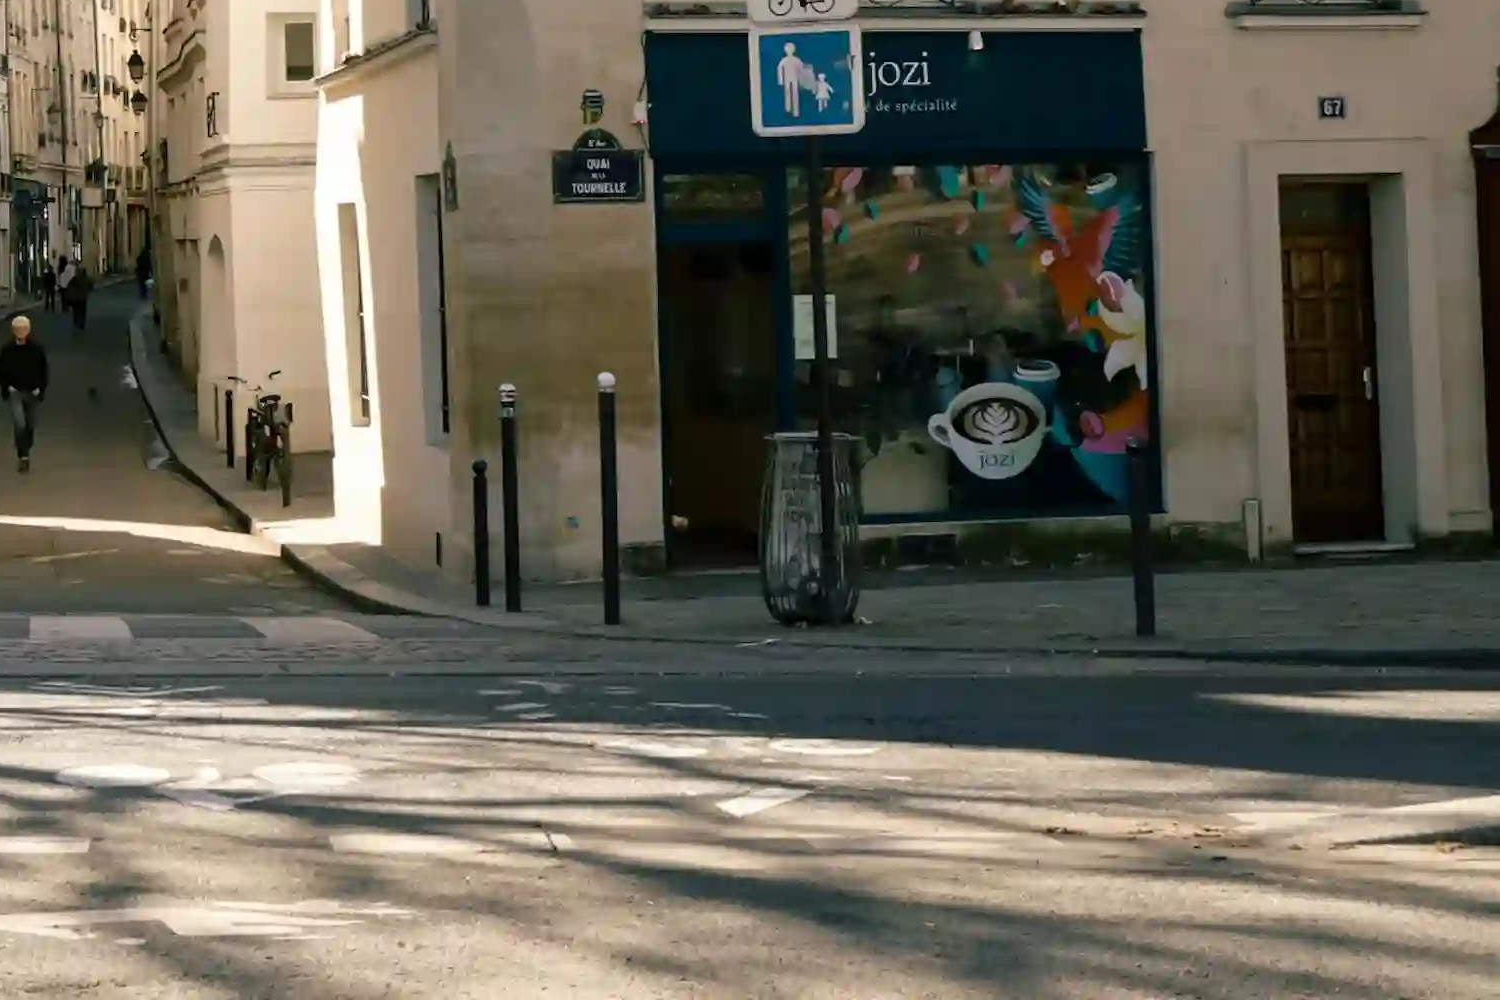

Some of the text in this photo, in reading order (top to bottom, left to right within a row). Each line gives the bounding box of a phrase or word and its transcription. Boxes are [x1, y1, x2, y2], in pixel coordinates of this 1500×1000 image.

[867, 51, 932, 97] jozi
[875, 100, 890, 112] de
[895, 99, 958, 115] spécialité
[1323, 99, 1341, 115] 67
[586, 158, 610, 170] QUAI
[572, 182, 627, 194] TOURNELLE
[978, 450, 1016, 471] jozi
